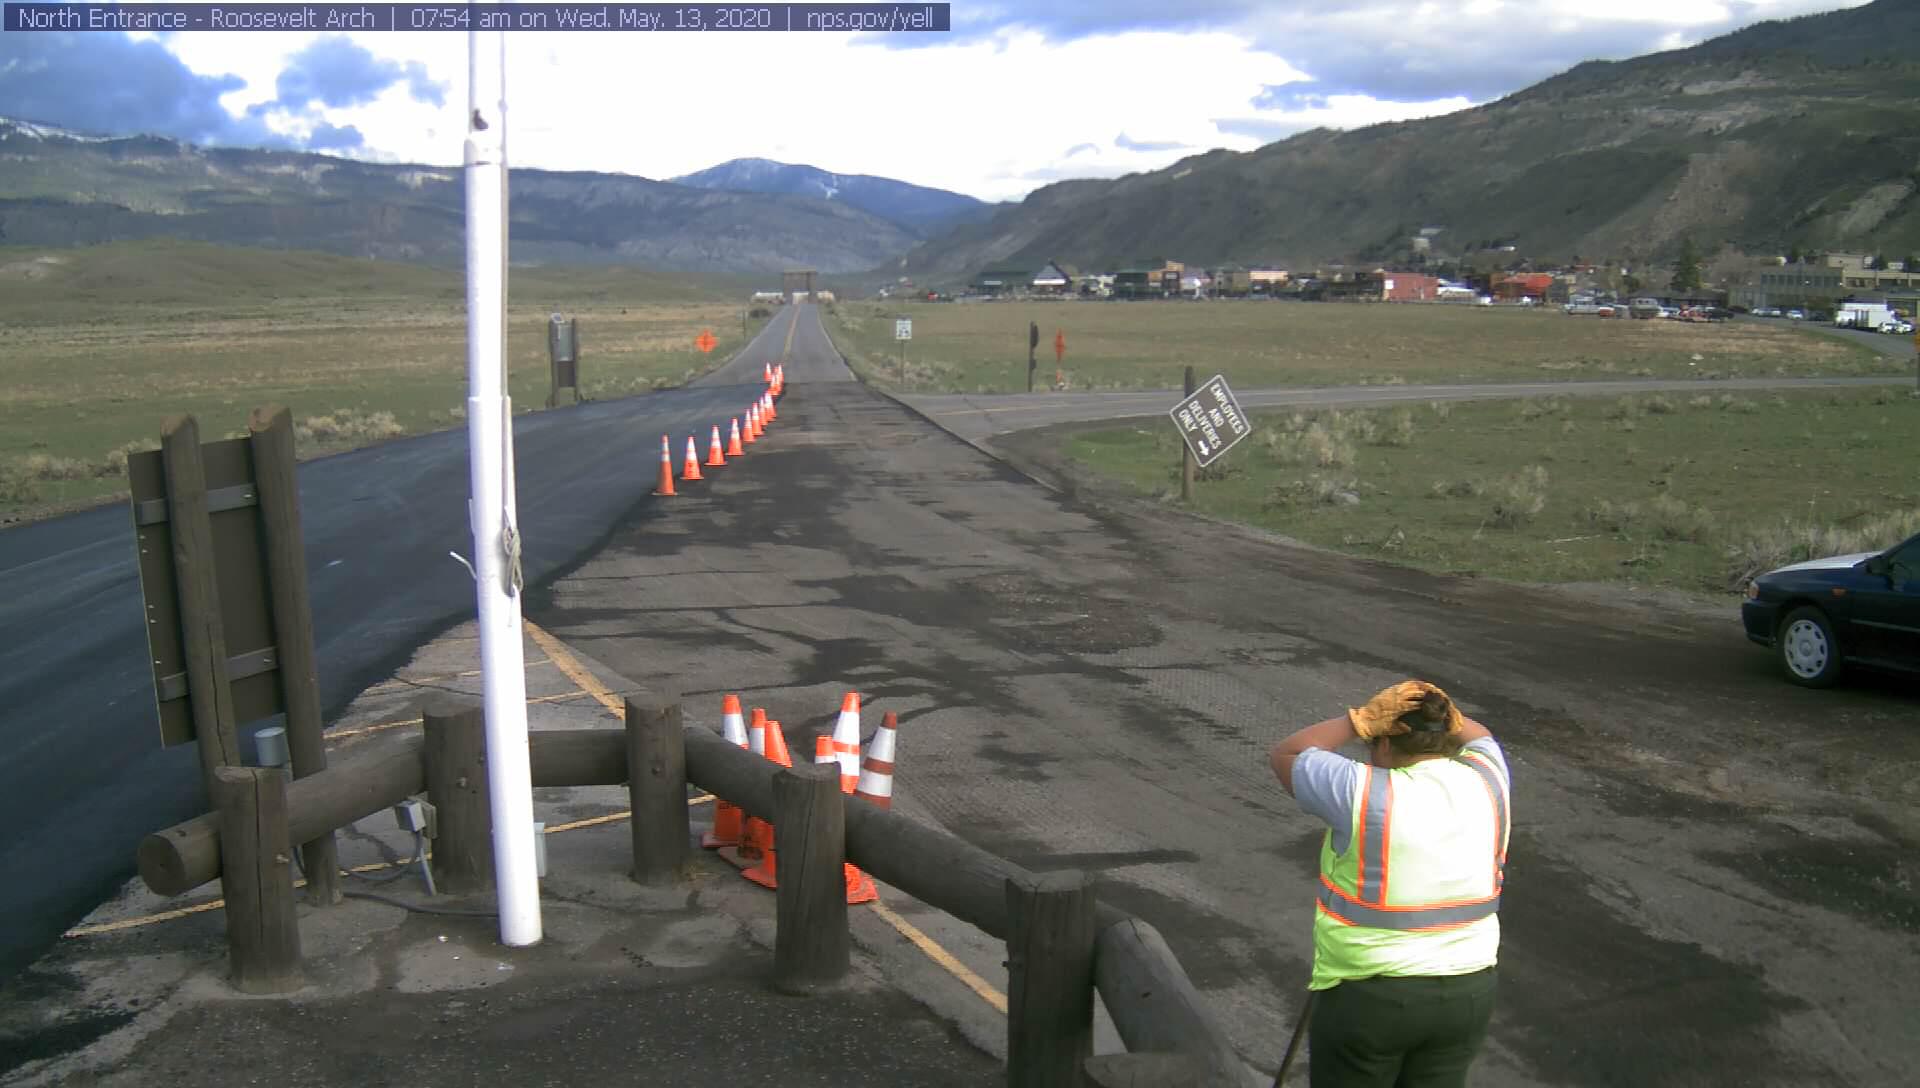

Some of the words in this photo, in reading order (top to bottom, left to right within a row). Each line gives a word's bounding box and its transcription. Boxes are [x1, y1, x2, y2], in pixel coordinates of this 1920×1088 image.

[1178, 409, 1199, 432] ONLY
[1188, 400, 1222, 449] DELIVERIES
[1208, 408, 1225, 428] AND
[1210, 383, 1244, 434] EMPLOYEES
